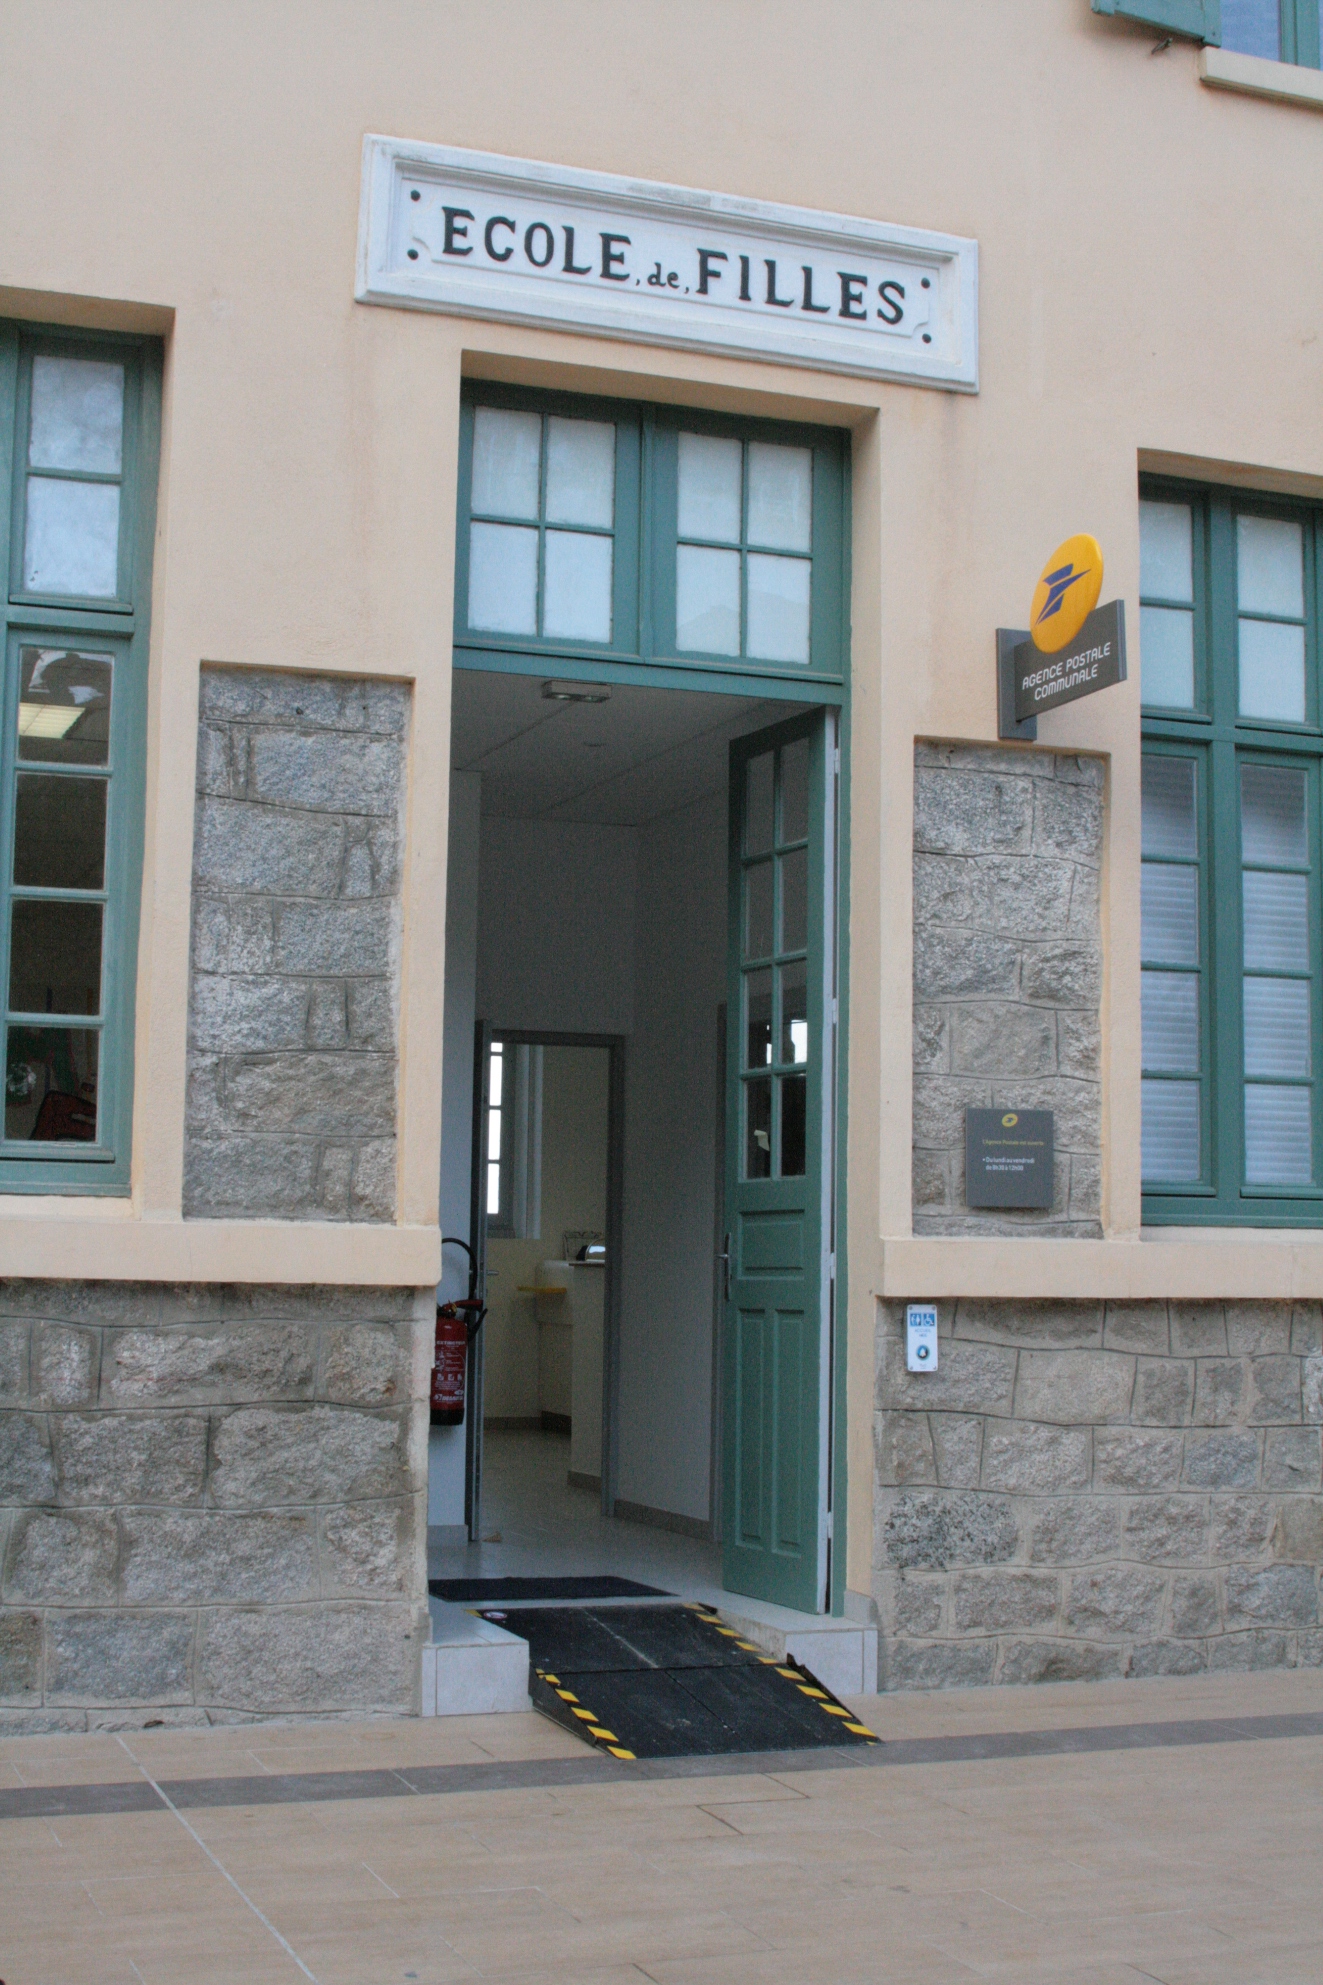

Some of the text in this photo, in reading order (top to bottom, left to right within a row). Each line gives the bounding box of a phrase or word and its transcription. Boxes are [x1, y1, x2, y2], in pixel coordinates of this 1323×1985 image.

[696, 247, 906, 326] FILLES
[1022, 641, 1111, 690] AGENCE POSTALE
[1034, 663, 1099, 701] COMMUNALE
